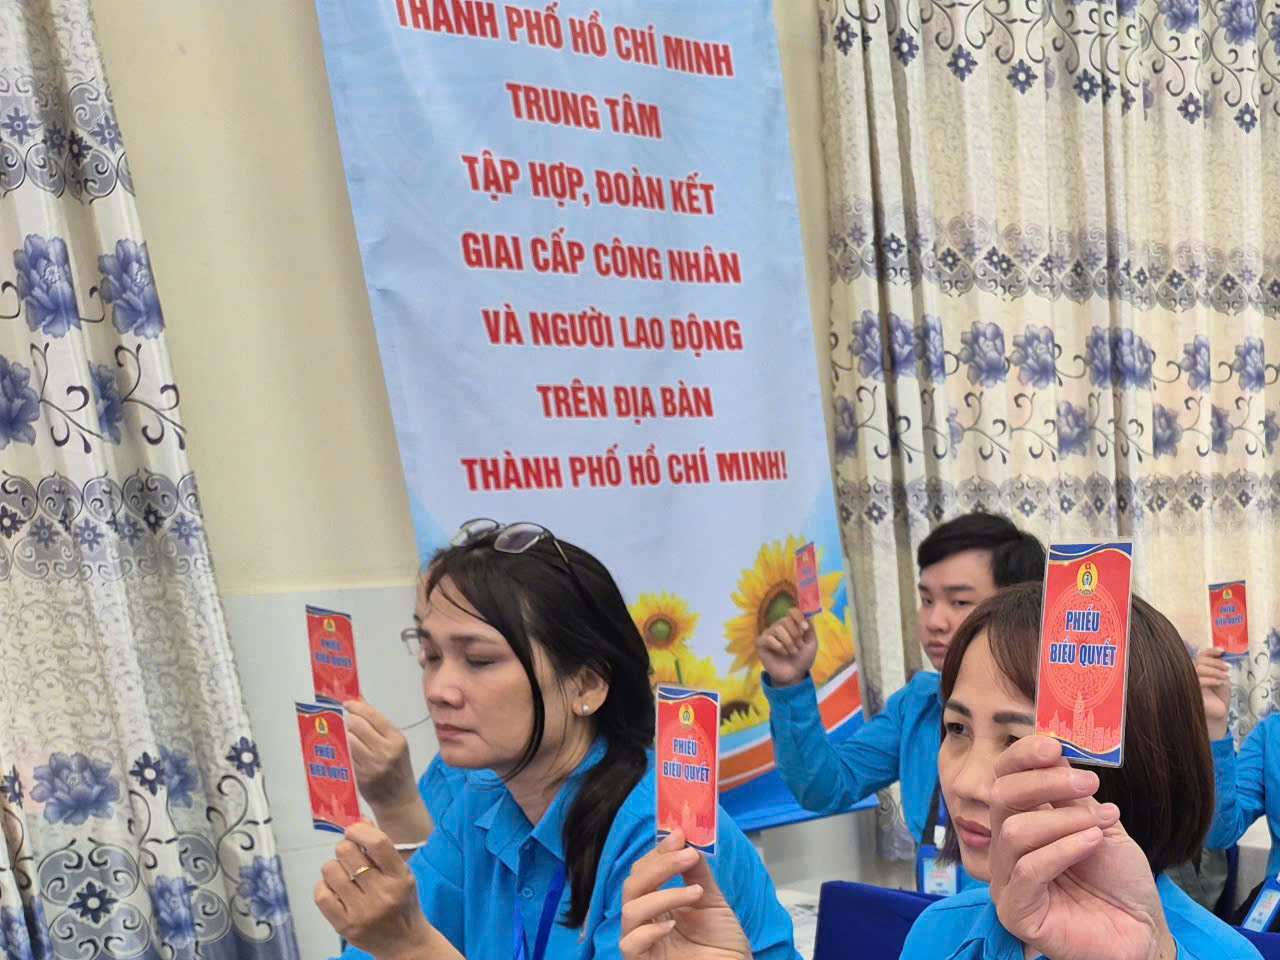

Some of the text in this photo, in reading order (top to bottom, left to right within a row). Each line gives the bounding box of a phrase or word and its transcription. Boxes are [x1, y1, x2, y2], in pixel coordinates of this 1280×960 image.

[504, 1, 563, 49] PHỐ
[569, 10, 607, 57] HỒ
[614, 24, 659, 66] CHÍ
[663, 36, 734, 77] MINH
[505, 82, 662, 139] TRUNG TÂM
[462, 150, 715, 215] TẬP HỢP, ĐOÀN KẾT
[461, 228, 741, 284] GIAI CẤP CÔNG NHÂN
[482, 303, 743, 358] VÀ NGƯỜI LAO ĐỘNG
[537, 379, 714, 426] TRÊN ĐỊA BÀN
[461, 443, 788, 492] THÀNH PHỐ HỒ CHÍ MINH!
[1065, 604, 1101, 632] PHIẾU
[1050, 636, 1117, 667] BIỂU QUYẾT
[663, 758, 710, 782] BIỂU QUYẾT
[673, 736, 697, 756] PHIẾU
